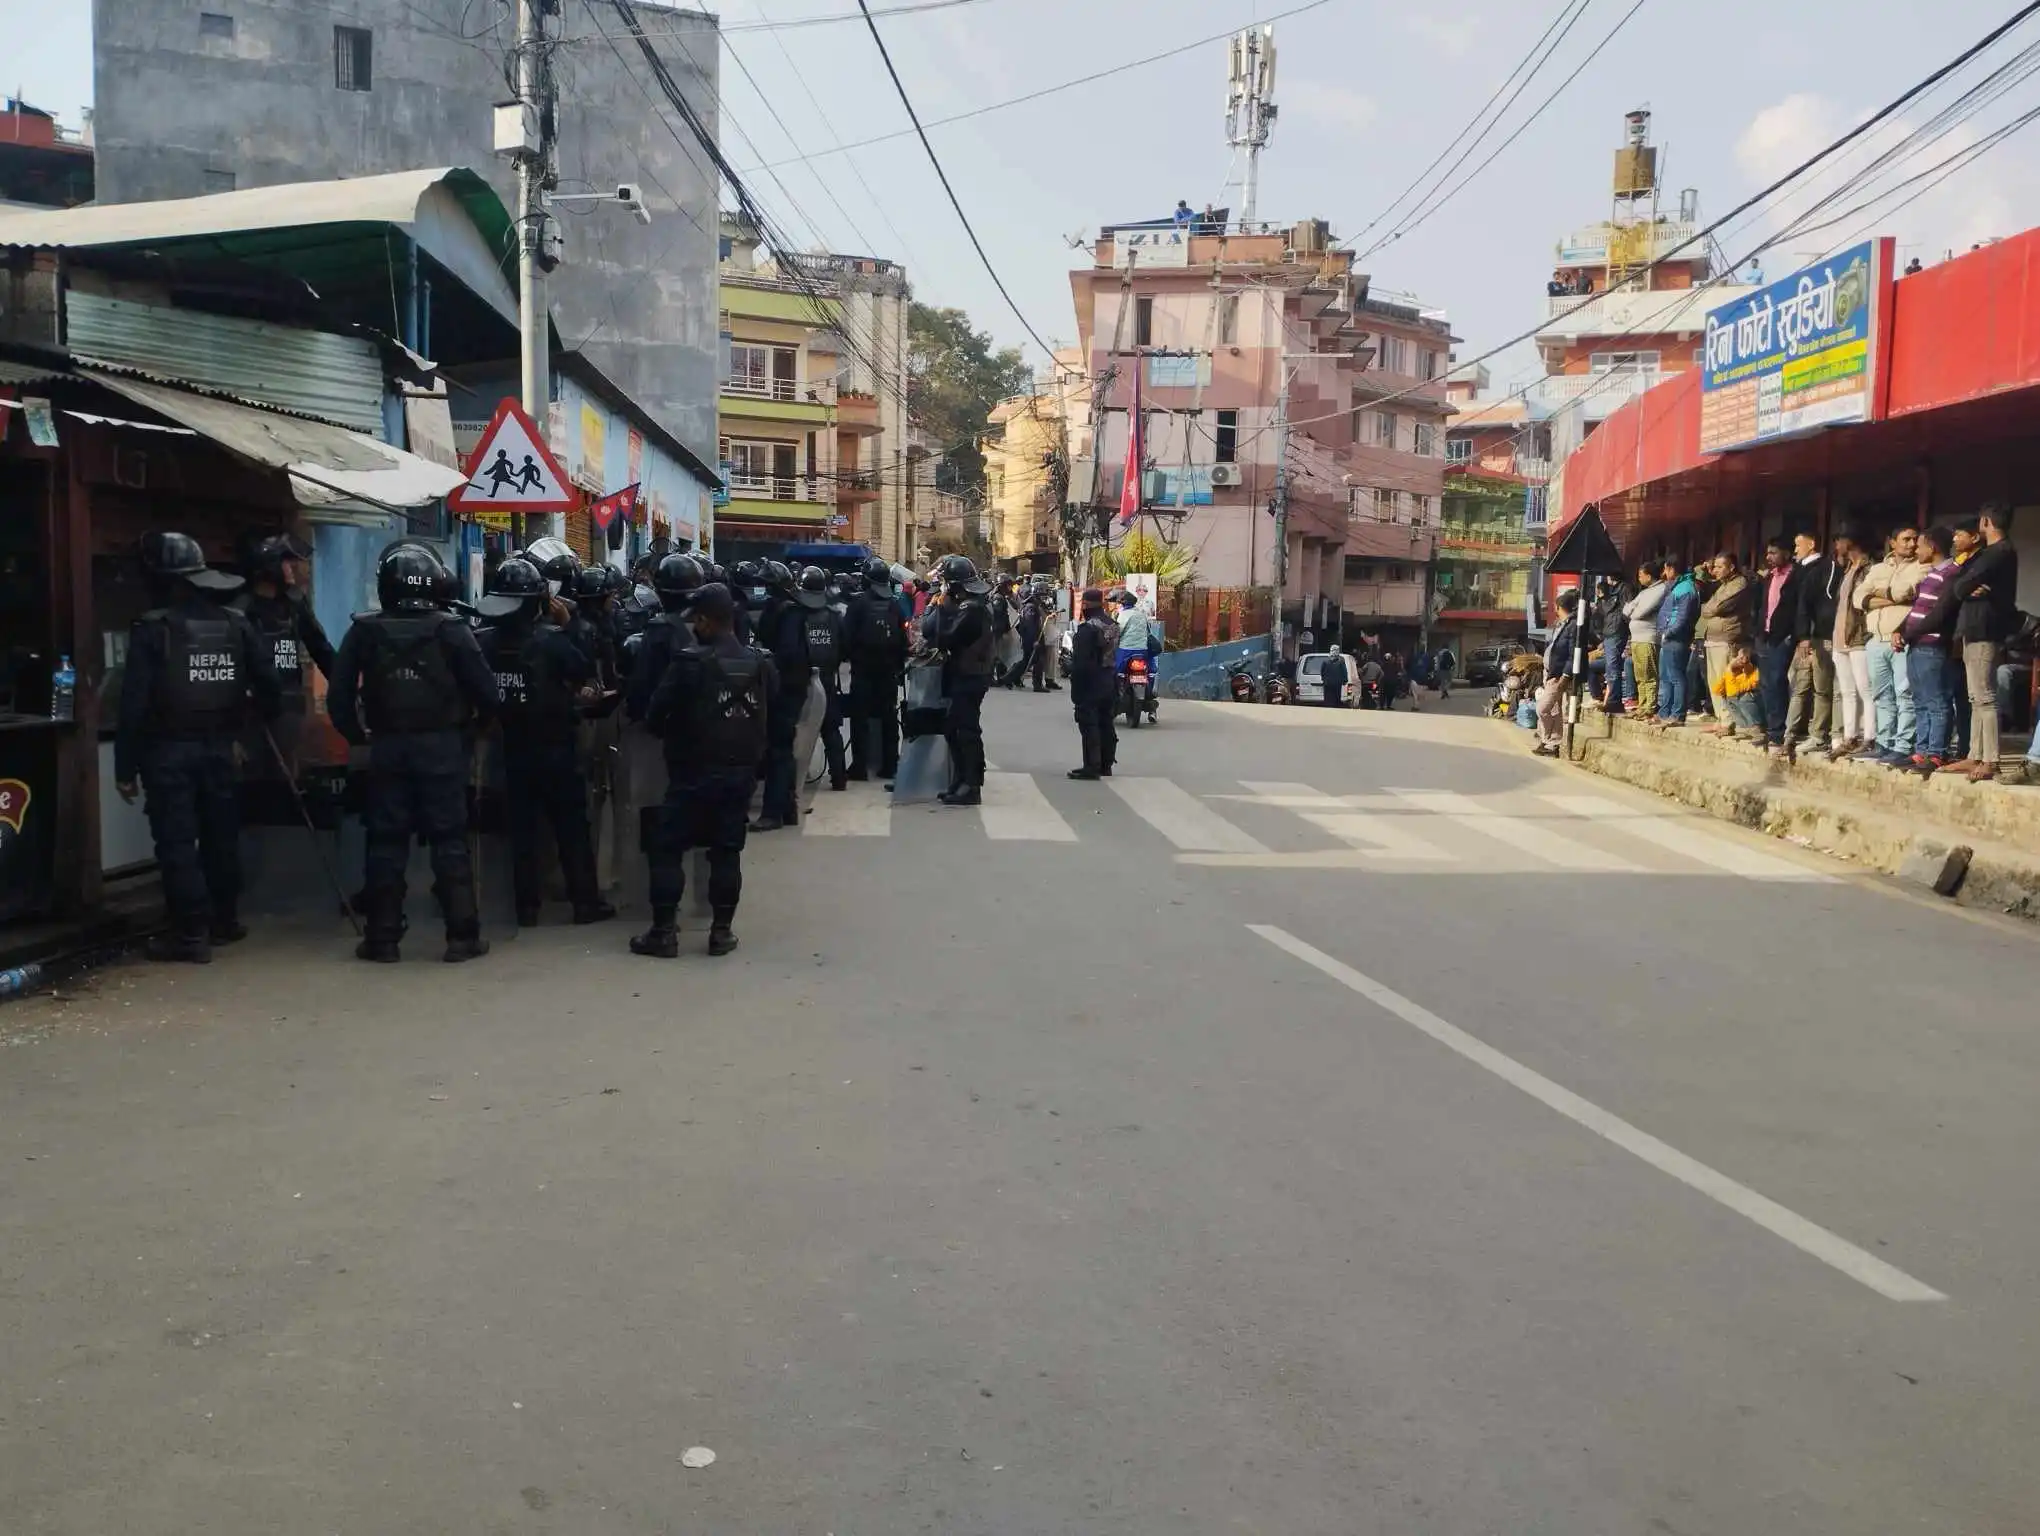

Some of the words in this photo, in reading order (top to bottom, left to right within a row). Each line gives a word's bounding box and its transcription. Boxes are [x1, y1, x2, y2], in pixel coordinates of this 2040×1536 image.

[1705, 316, 1735, 372] रिना
[1738, 294, 1773, 359] फोटो
[189, 653, 235, 667] NEPAL
[274, 654, 298, 669] POLICE
[189, 668, 235, 682] POLICE
